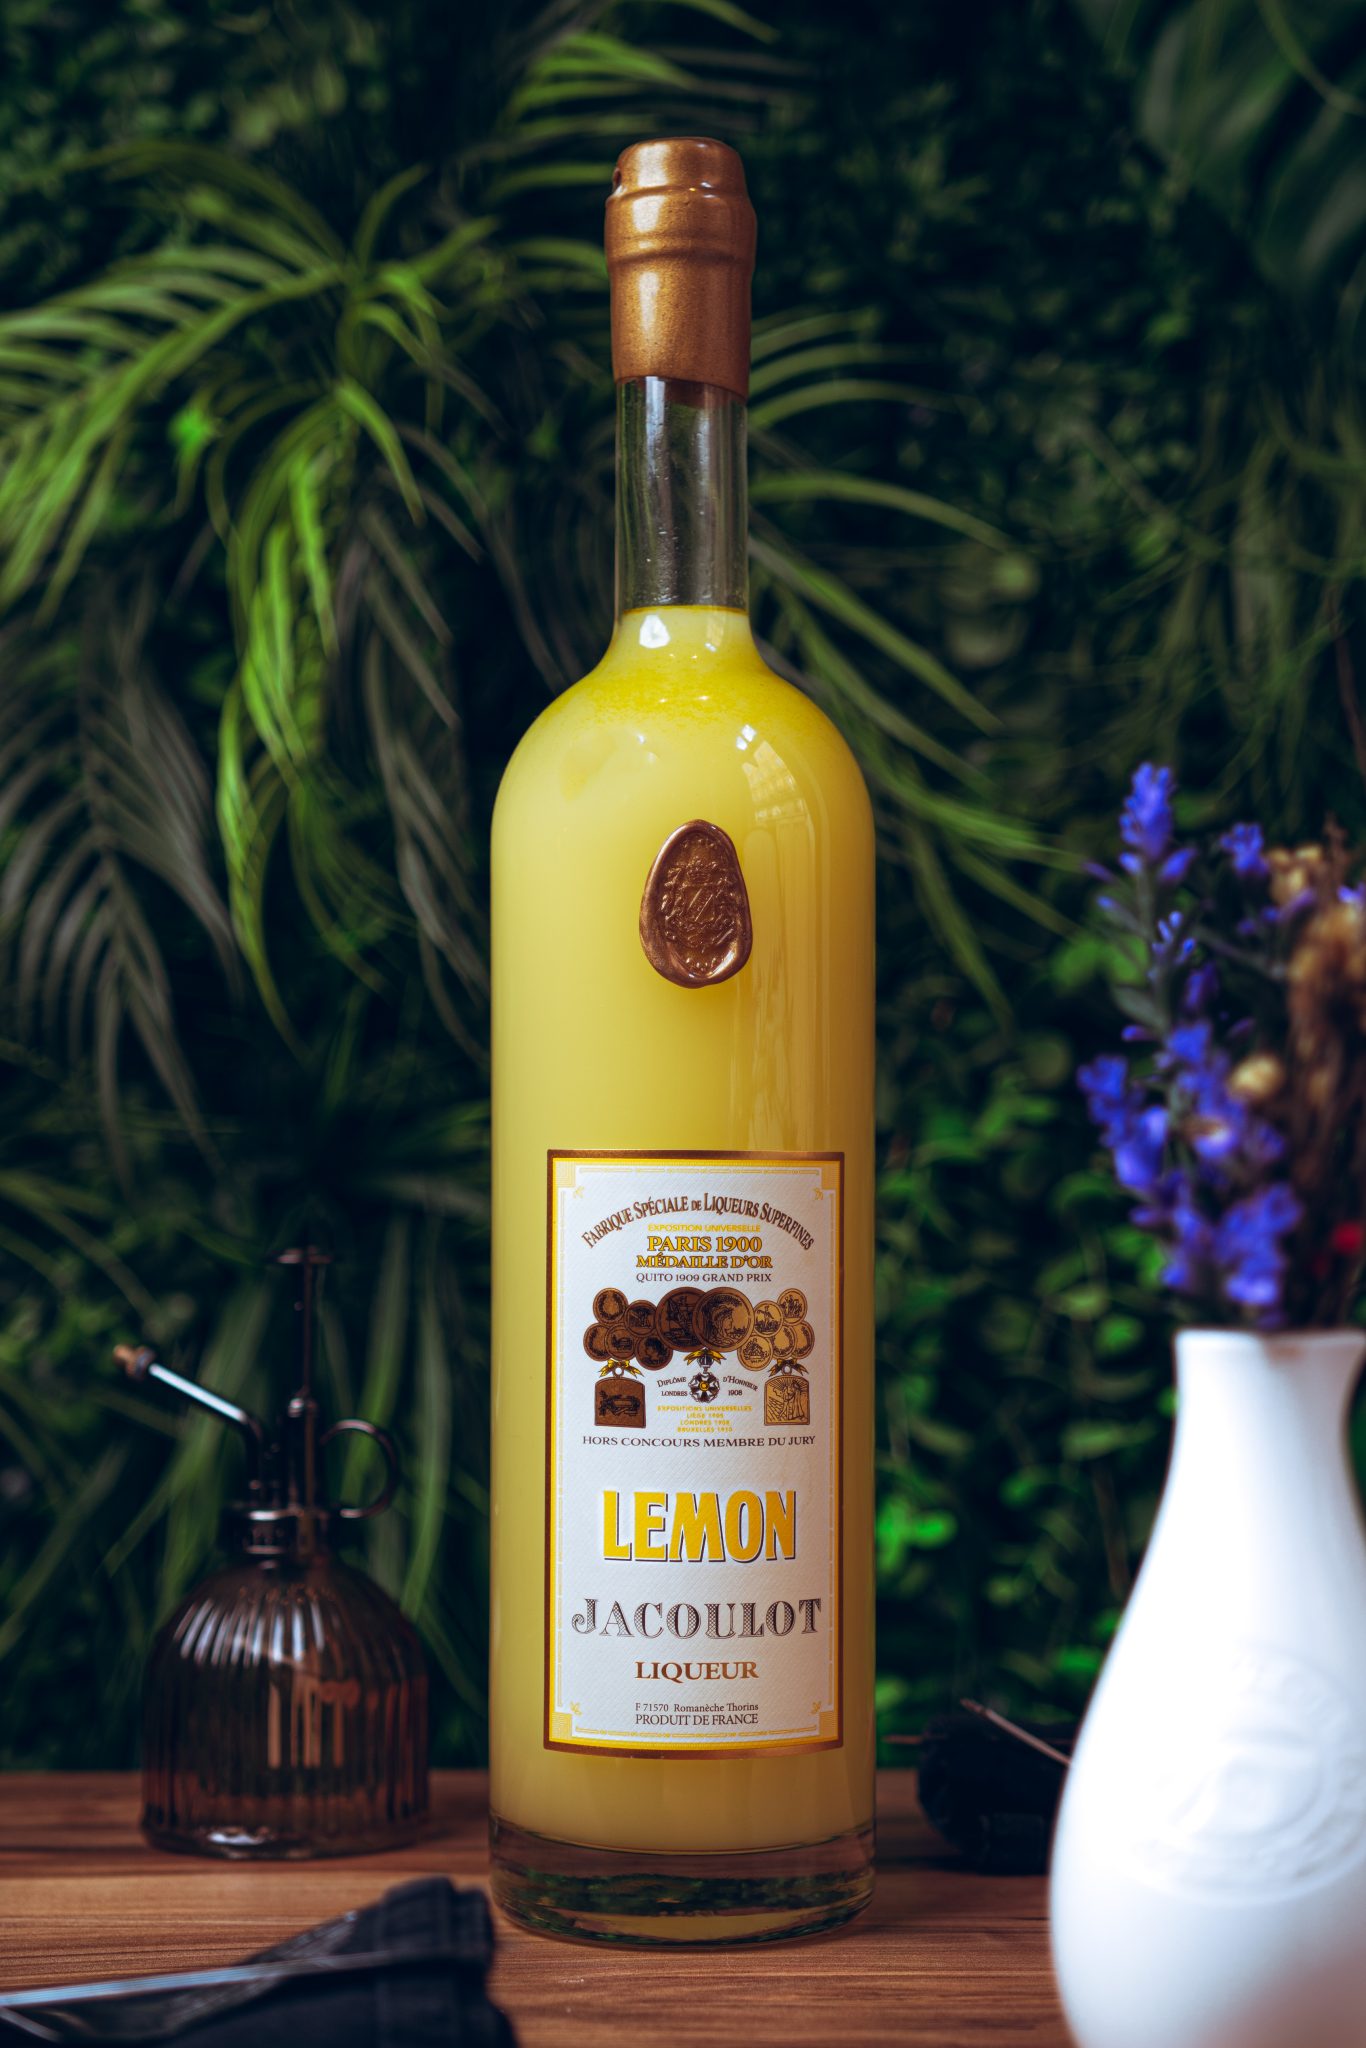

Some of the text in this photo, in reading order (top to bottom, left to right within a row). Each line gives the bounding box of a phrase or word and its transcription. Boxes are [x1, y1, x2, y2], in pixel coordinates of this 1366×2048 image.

[581, 1207, 634, 1249] FABRIQUE
[633, 1196, 689, 1219] SPÉCIALE
[704, 1192, 760, 1218] LIQUEURS
[760, 1202, 815, 1250] SUPERFINES
[648, 1223, 761, 1232] EXPOSITION UNIVERSELLE
[647, 1236, 762, 1252] PARIS 1900
[636, 1252, 729, 1268] MÉDAILLE
[636, 1273, 772, 1283] QUITO 1909 GRAND PRIX
[656, 1377, 687, 1387] DIPLÔME
[583, 1435, 816, 1447] HORS CONCOURS MEMBRE DU JURY
[602, 1490, 797, 1563] LEMON
[571, 1598, 822, 1640] JACOULOT
[635, 1661, 759, 1684] LIQUEUR
[635, 1702, 759, 1712] F 71570 Romanèche Thorins
[635, 1713, 759, 1726] PRODUIT DE FRANCE
